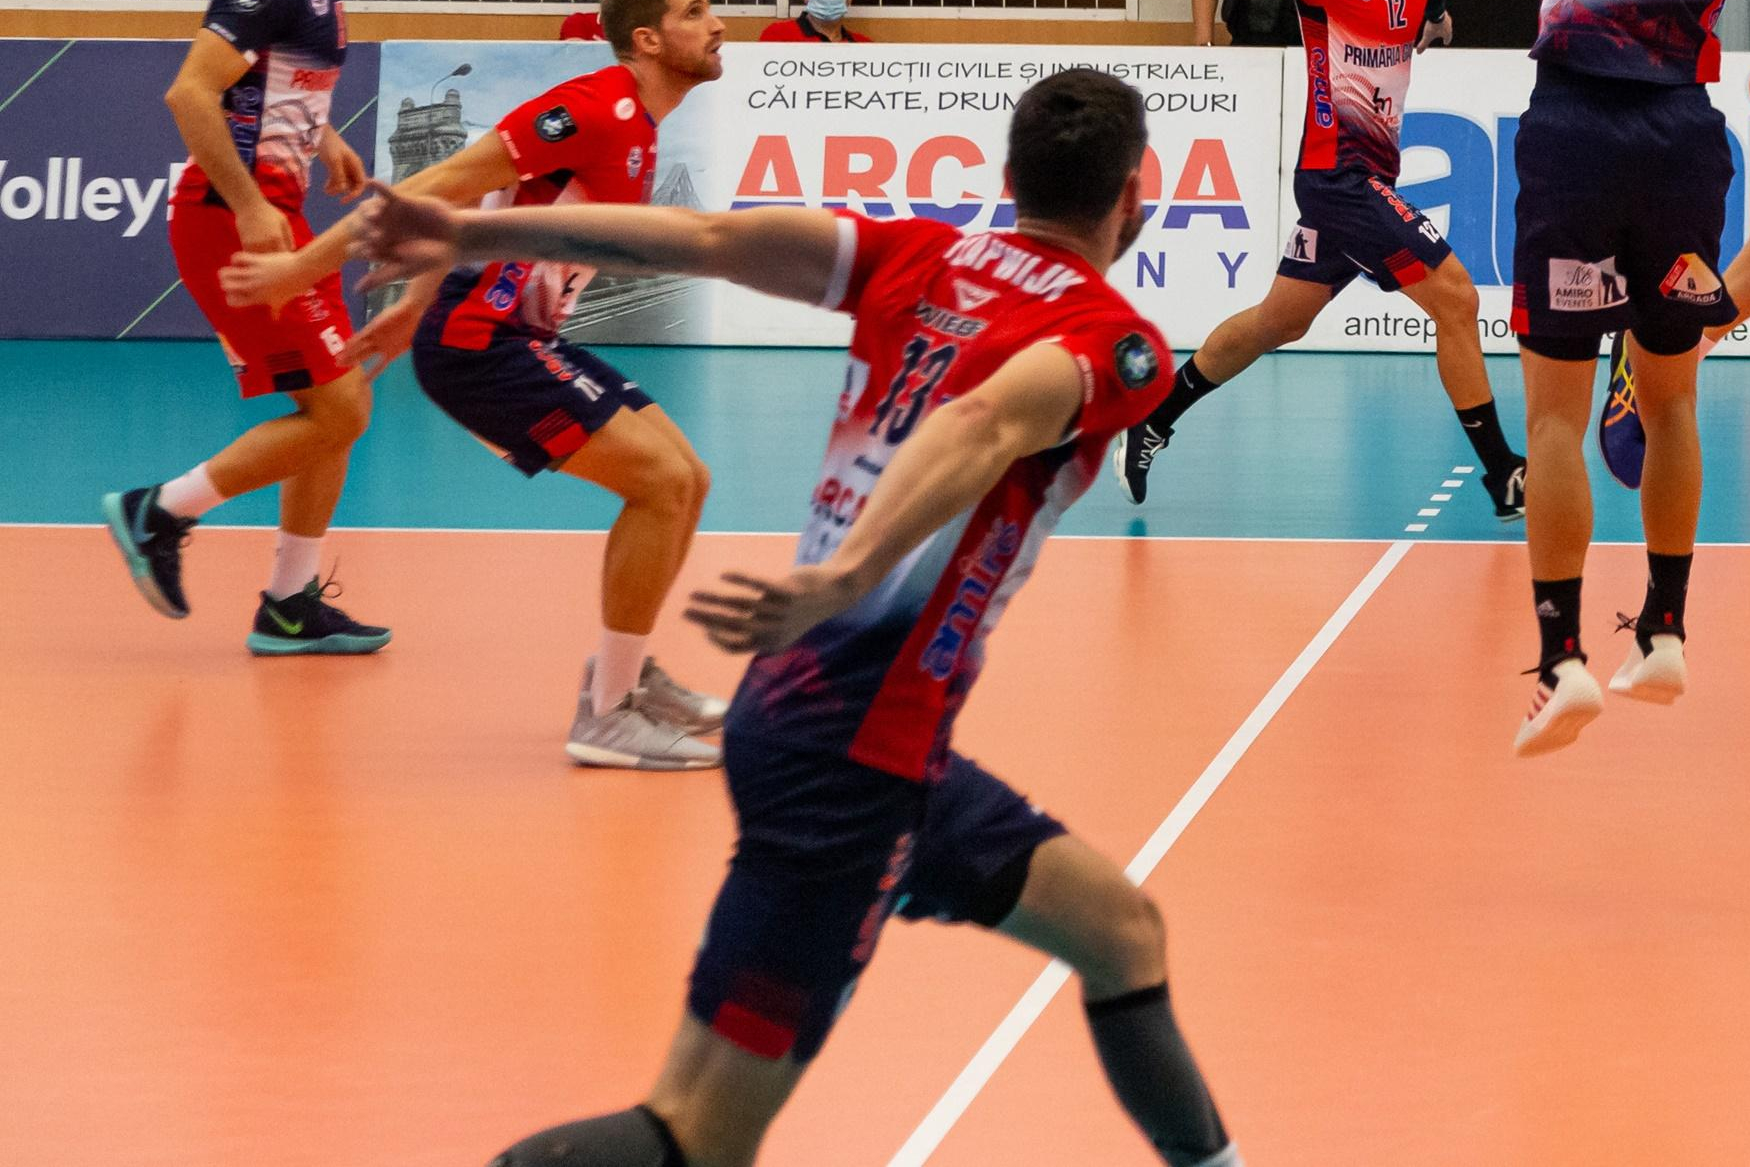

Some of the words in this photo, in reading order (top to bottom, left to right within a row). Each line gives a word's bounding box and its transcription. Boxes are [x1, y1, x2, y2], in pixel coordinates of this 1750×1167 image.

[763, 60, 931, 83] CONSTRUCȚII
[937, 62, 1013, 80] CIVILE
[748, 86, 797, 111] CĂI
[806, 91, 929, 114] FERATE,
[1144, 92, 1238, 113] ODURI
[1418, 219, 1441, 245] 12
[1555, 287, 1593, 299] AMIRO
